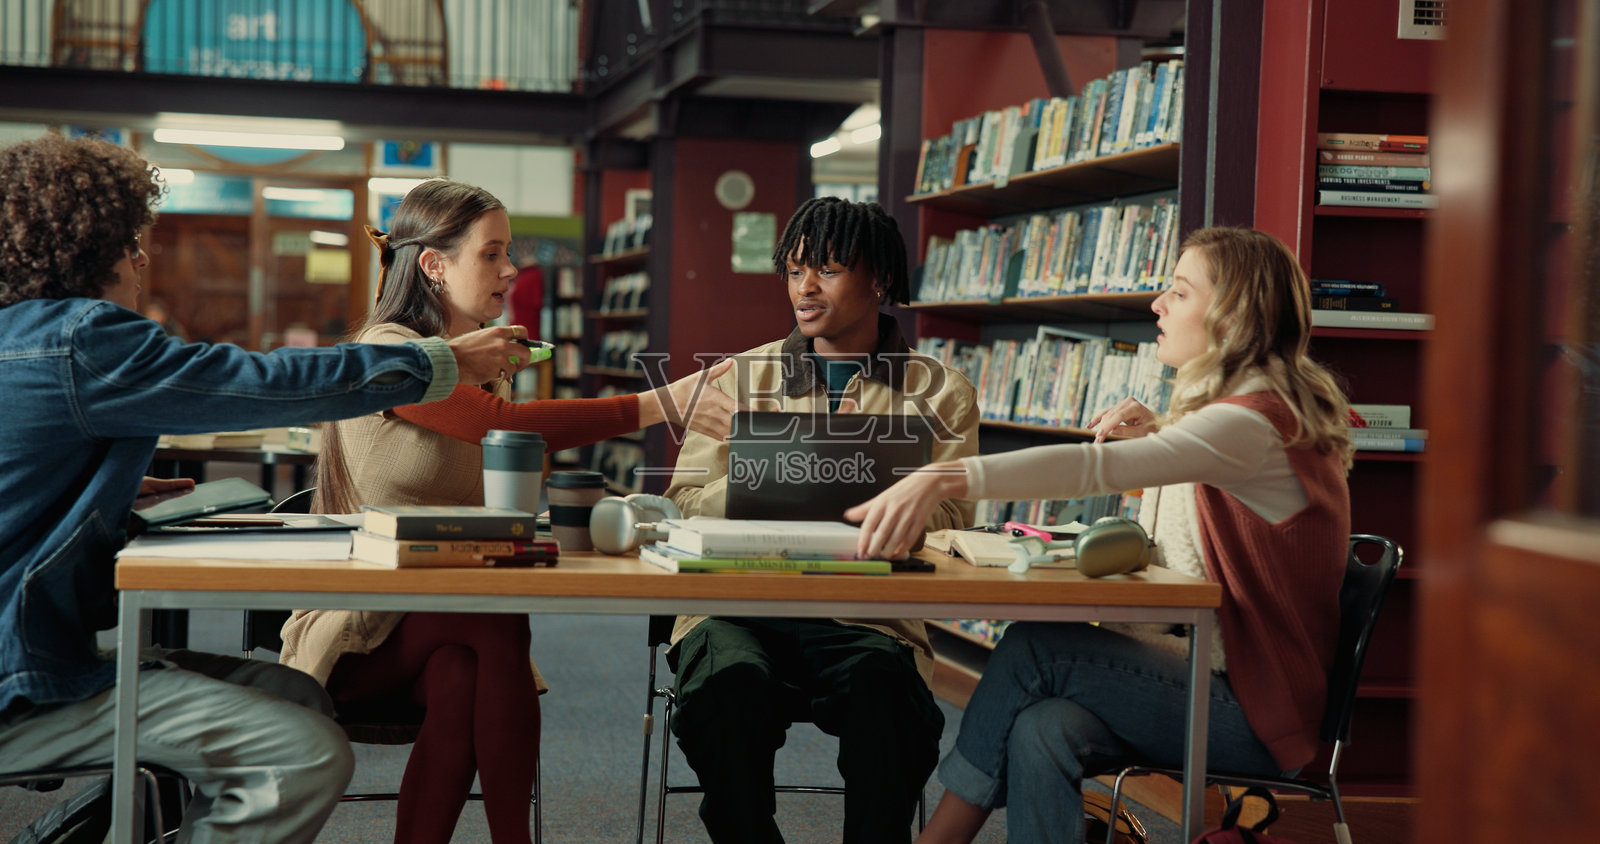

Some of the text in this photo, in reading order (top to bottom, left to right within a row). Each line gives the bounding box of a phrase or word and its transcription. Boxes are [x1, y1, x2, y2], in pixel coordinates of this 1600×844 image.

[228, 11, 277, 41] art
[436, 524, 448, 532] The
[450, 543, 513, 554] Mathematics
[734, 559, 798, 569] CHEMISTRY
